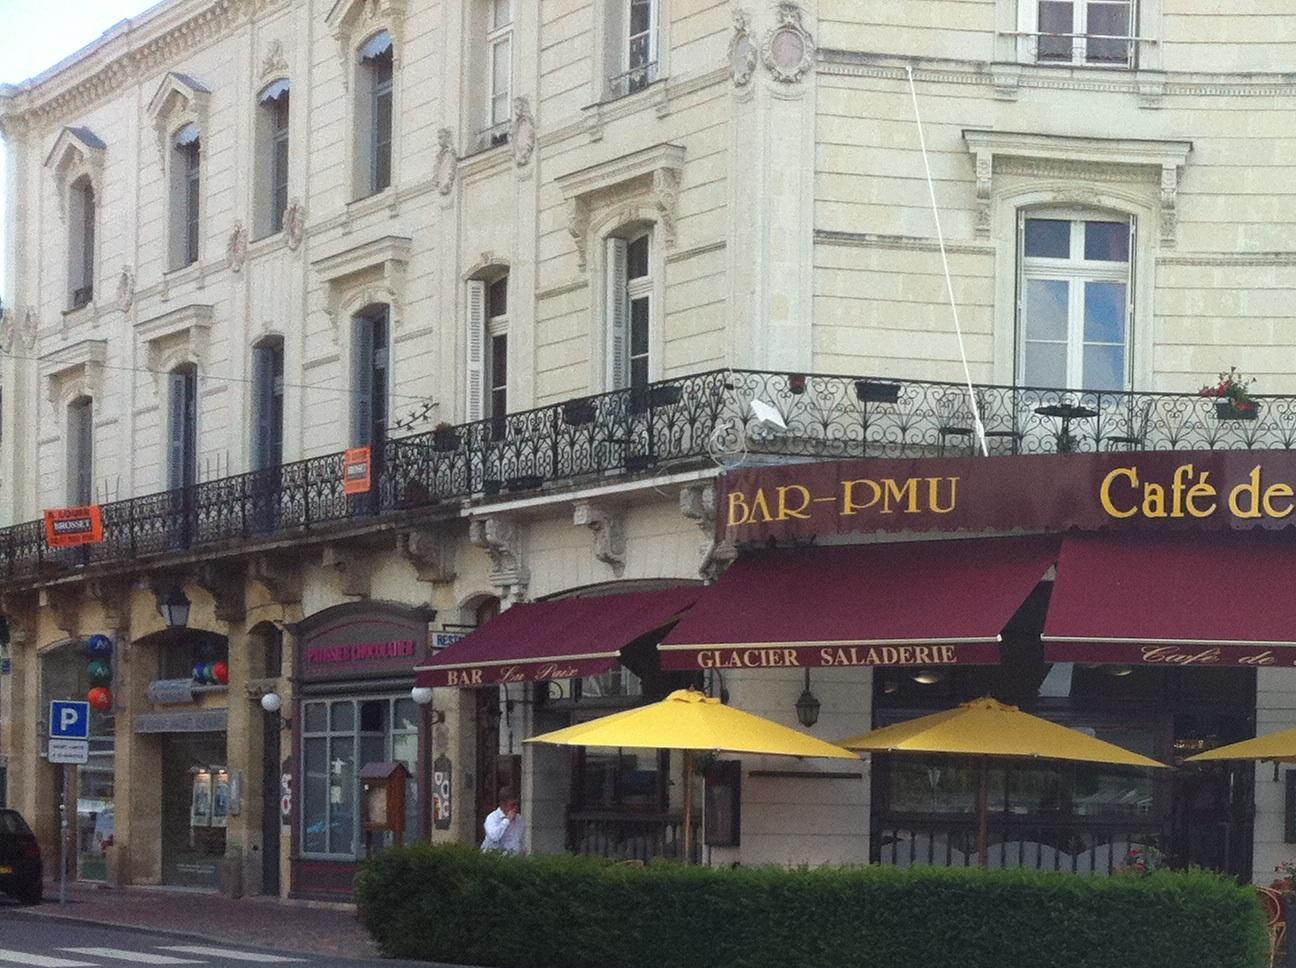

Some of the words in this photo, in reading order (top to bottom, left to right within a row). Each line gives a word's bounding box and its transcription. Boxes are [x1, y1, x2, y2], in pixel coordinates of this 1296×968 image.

[1100, 464, 1217, 518] Café
[1228, 464, 1295, 518] de
[54, 519, 90, 531] BROSSET
[697, 648, 800, 668] GLACIER
[820, 645, 958, 667] SALADERIE
[1141, 645, 1220, 665] Café
[1238, 650, 1278, 665] de
[447, 669, 483, 686] BAR
[498, 666, 524, 682] La
[534, 663, 579, 680] Paix
[61, 708, 78, 731] P
